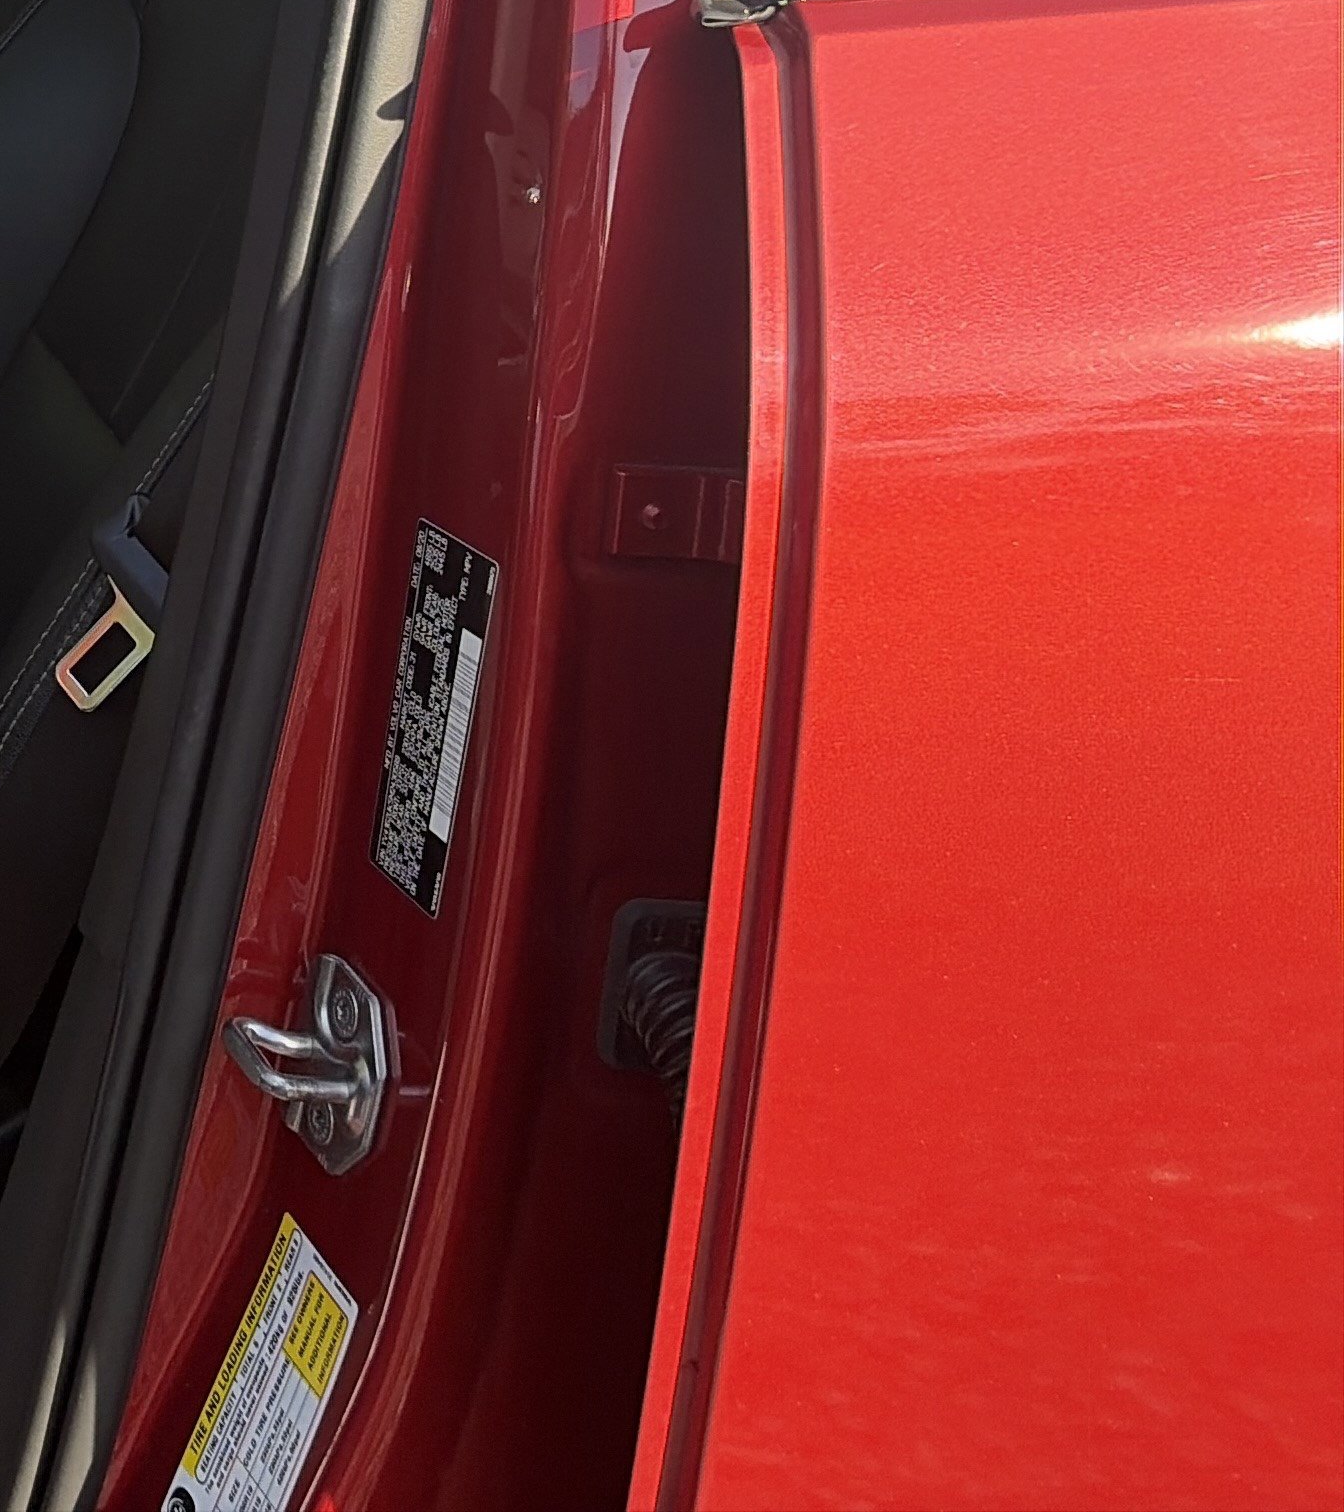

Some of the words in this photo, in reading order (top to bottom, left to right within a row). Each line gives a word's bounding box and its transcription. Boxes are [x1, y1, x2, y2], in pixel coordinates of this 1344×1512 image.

[390, 700, 398, 731] VOLVO
[398, 616, 411, 676] CORPORATION
[190, 1421, 206, 1455] TIRE
[204, 1389, 220, 1423] AND
[219, 1327, 246, 1390] LOADING
[245, 1232, 286, 1328] INFORMATION
[201, 1434, 217, 1473] SEATING
[216, 1390, 236, 1436] CAPACITY
[240, 1348, 253, 1378] TOTAL
[263, 1292, 277, 1324] FRONT
[284, 1245, 295, 1271] REAR
[289, 1324, 297, 1344] SEE
[298, 1314, 315, 1358] MANUAL
[314, 1292, 323, 1314] FOR
[307, 1310, 331, 1371] ADDITIONAL
[317, 1313, 344, 1384] INFORMATION
[243, 1437, 256, 1467] COLD
[255, 1411, 266, 1437] TIRE
[266, 1355, 289, 1413] PRESSURE
[228, 1478, 239, 1503] SIZE
